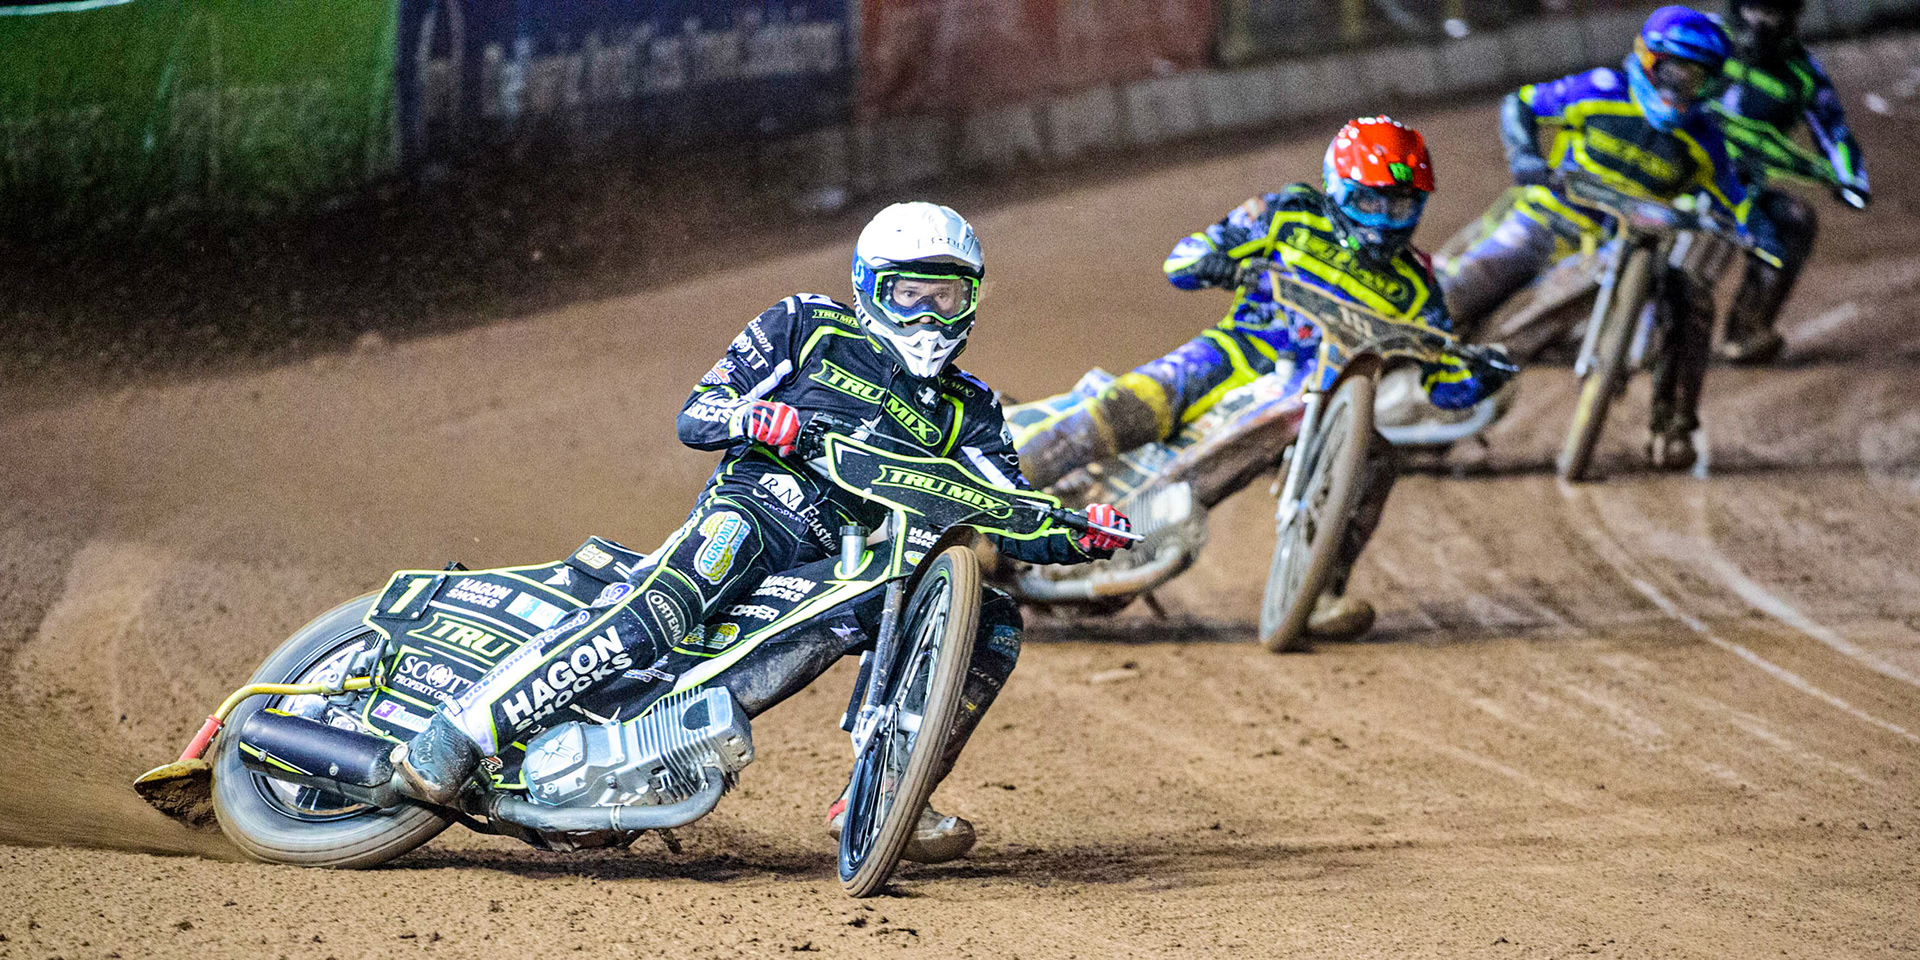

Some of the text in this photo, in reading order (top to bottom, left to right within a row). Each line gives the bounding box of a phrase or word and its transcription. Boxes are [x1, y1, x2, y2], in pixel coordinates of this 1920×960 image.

[731, 330, 769, 371] OTT
[827, 369, 934, 440] TRU MIX
[889, 470, 1003, 515] TRU MIX
[702, 516, 739, 570] AGROMIX
[387, 578, 432, 614] 1
[446, 587, 500, 609] SHOCKS
[455, 577, 513, 600] HAGON
[751, 587, 805, 603] SHOCKS
[760, 575, 817, 594] HAGON
[430, 618, 513, 659] TRU
[501, 625, 624, 726] HAGON
[515, 652, 633, 734] SHOCKS
